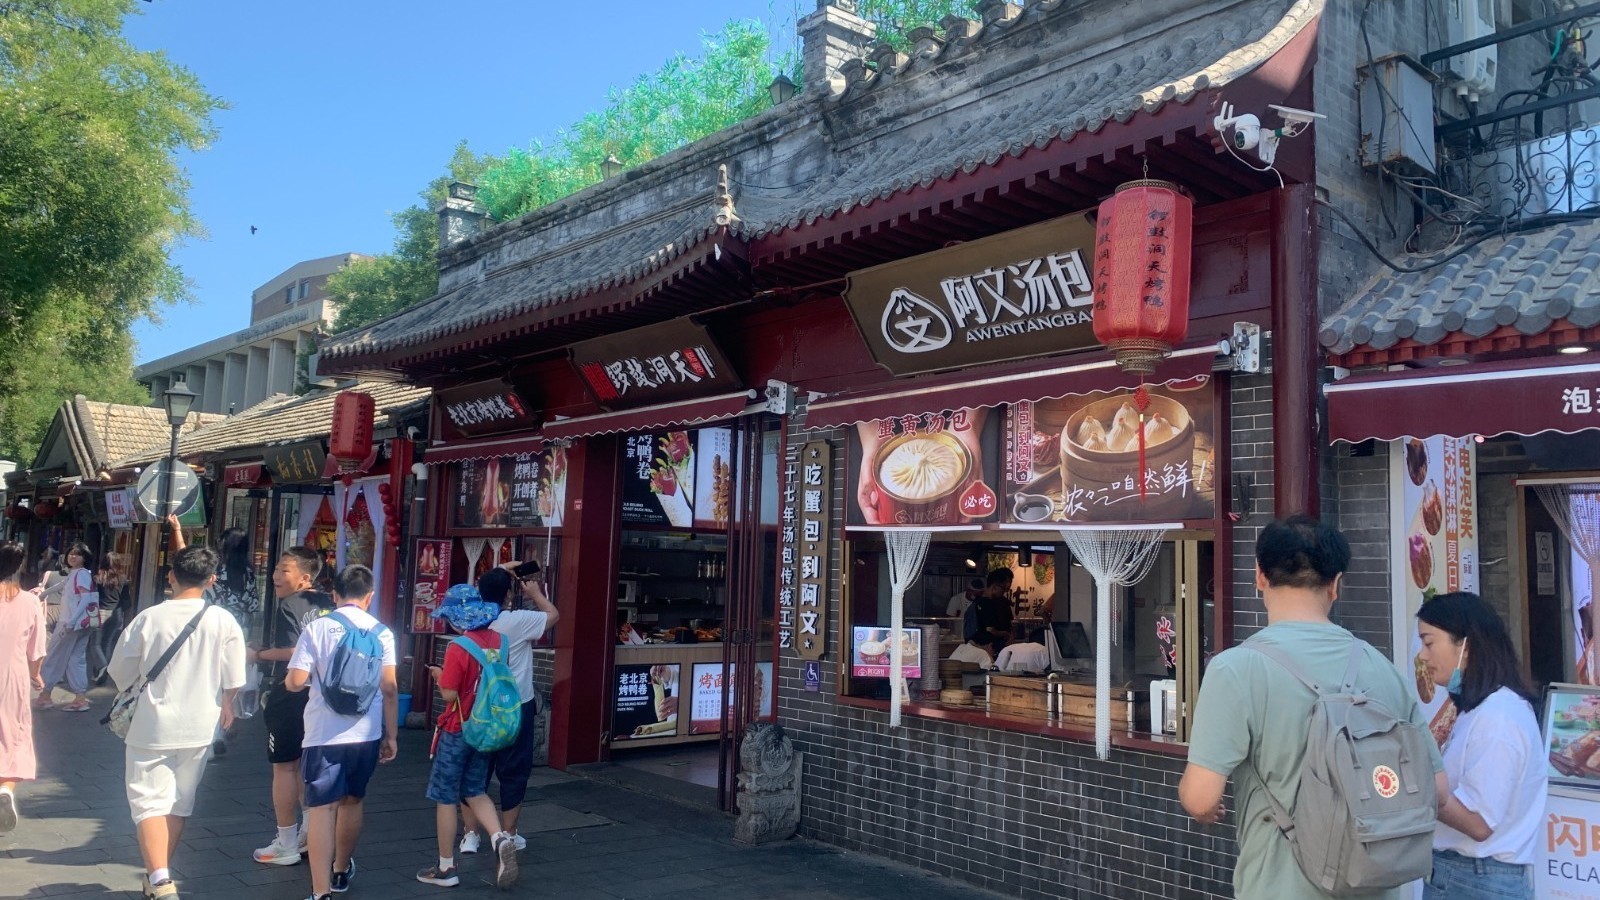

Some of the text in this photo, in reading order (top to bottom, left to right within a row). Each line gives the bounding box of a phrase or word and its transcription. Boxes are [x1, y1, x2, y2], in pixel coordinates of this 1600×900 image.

[940, 248, 1094, 328] 阿文汤包
[1561, 386, 1600, 415] 泡
[877, 410, 972, 439] 蟹黄汤包
[964, 494, 992, 510] 必吃
[1459, 438, 1473, 540] 电泡芙
[618, 684, 648, 696] 烤鸭卷
[619, 672, 648, 685] 老北京
[1547, 812, 1600, 858] 闪
